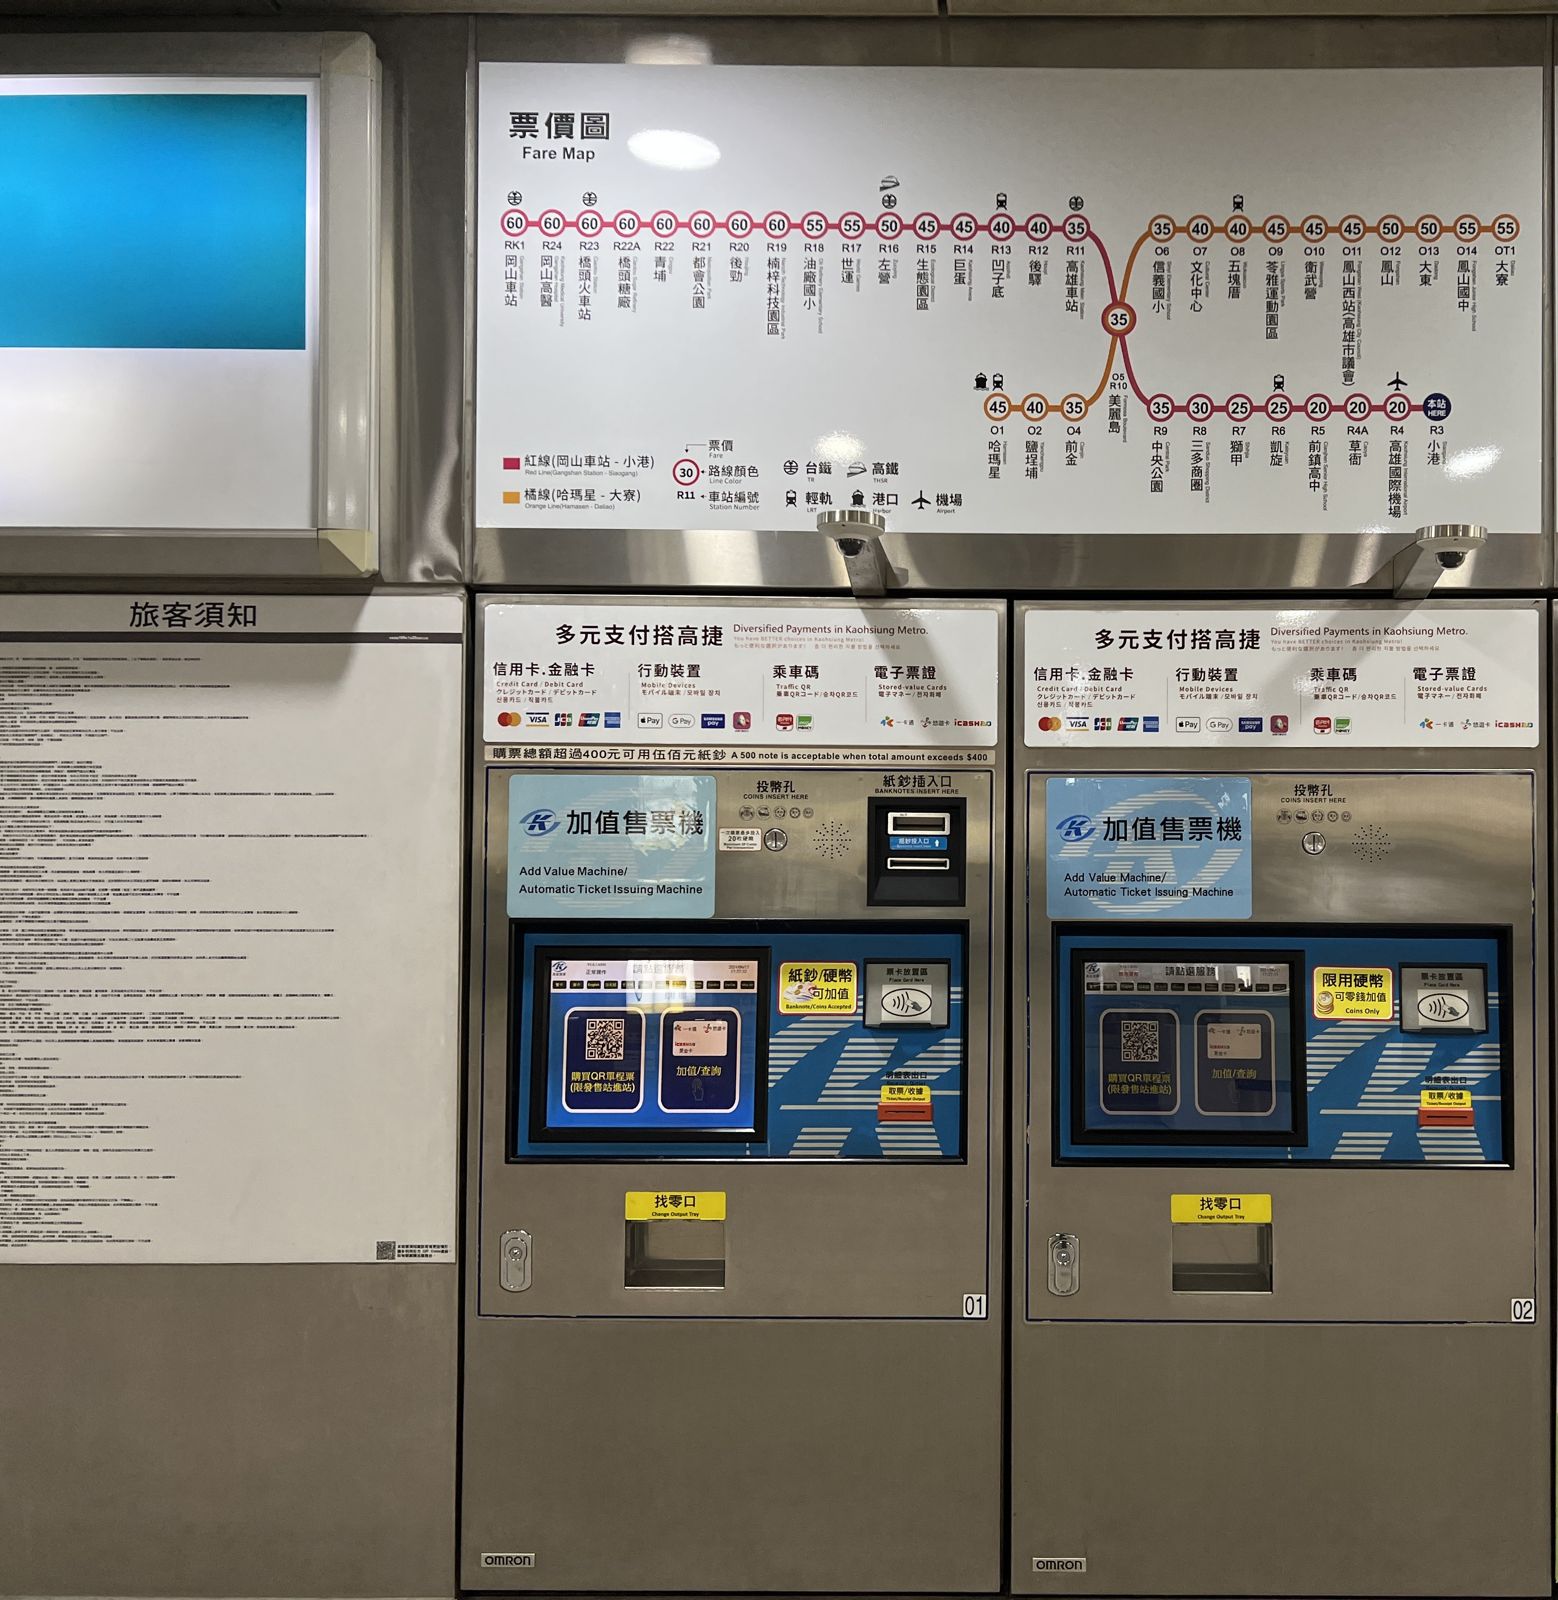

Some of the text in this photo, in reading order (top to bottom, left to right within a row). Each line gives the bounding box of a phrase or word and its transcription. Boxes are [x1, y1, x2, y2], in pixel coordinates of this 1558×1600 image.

[509, 112, 609, 139] 票價圖
[523, 147, 595, 162] Fare Map
[507, 217, 522, 229] 60
[582, 218, 599, 231] 60
[805, 220, 824, 233] 55
[880, 219, 899, 233] 50
[955, 221, 973, 234] 45
[1029, 220, 1048, 234] 40
[1067, 221, 1085, 235] 35
[1267, 222, 1284, 235] 45
[1420, 223, 1438, 236] 50
[1496, 221, 1515, 235] 55
[505, 241, 524, 249] RK1
[614, 242, 640, 250] R22A
[767, 243, 786, 252] R19
[879, 244, 898, 253] R16
[992, 245, 1011, 254] R13
[1067, 246, 1084, 255] R11
[1304, 247, 1324, 256] O10
[1457, 247, 1477, 255] O14
[1495, 246, 1514, 255] OT1
[730, 257, 742, 282] 後勁
[841, 258, 854, 283] 世運
[954, 259, 966, 284] 巨蛋
[1381, 261, 1394, 285] 鳳山
[1420, 260, 1432, 286] 大東
[1496, 260, 1508, 286] 大寮
[505, 255, 517, 306] 岡山車站
[541, 256, 552, 307] 岡山高醫
[693, 257, 705, 308] 都會公園
[804, 257, 816, 310] 油廠國小
[917, 259, 929, 310] 生態園區
[992, 260, 1004, 298] 凹子底
[1228, 260, 1240, 298] 五塊厝
[579, 256, 591, 320] 橋頭火車站
[1065, 260, 1078, 312] 高雄車站
[1190, 261, 1203, 312] 文化中心
[1108, 311, 1129, 327] 35
[989, 401, 1007, 415] 45
[1191, 402, 1209, 415] 30
[1269, 401, 1288, 415] 25
[1388, 402, 1406, 415] 20
[1427, 399, 1446, 408] 本站
[1109, 394, 1121, 433] 美麗島
[1028, 426, 1042, 435] O2
[1154, 427, 1167, 435] R9
[1233, 427, 1246, 435] R7
[1348, 426, 1368, 435] R4A
[1430, 426, 1444, 434] R3
[709, 440, 733, 451] 票價
[988, 440, 1001, 478] 哈瑪星
[1270, 441, 1283, 466] 凱旋
[1428, 440, 1440, 465] 小港
[525, 455, 654, 469] 紅線(岡山車站 小港)
[1025, 441, 1038, 479] 鹽埕埔
[1151, 440, 1163, 492] 中央公園
[1191, 441, 1203, 491] 三多商圈
[1309, 440, 1321, 492] 前鎮高中
[680, 468, 693, 477] 30
[709, 465, 759, 480] 路線顏色
[806, 461, 832, 475] 台鐵
[873, 462, 898, 475] 高鐵
[1389, 440, 1402, 518] 高雄國際機場
[525, 488, 640, 502] 橘線(哈瑪星 大寮)
[678, 491, 695, 499] R11
[709, 491, 759, 503] 車站編號
[806, 492, 832, 504] 輕軌
[873, 493, 898, 505] 港口
[936, 493, 962, 506] 機場
[130, 602, 256, 628] 旅客須知
[556, 624, 723, 646] 多元支付搭高捷
[734, 624, 928, 636] Diversified Payments Kaohsiung Metro.
[1095, 629, 1260, 649] 多元支付搭高捷
[493, 662, 594, 676] 信用卡.金融卡
[638, 664, 700, 677] 行動裝置
[773, 665, 818, 679] 乘車碼
[875, 666, 936, 679] 電子票證
[1176, 668, 1237, 681] 行動裝置
[1413, 667, 1476, 681] 電子票證
[1185, 721, 1198, 729] Pay
[493, 747, 727, 760] 購票總額超過400元可用伍佰元紙鈔
[791, 753, 841, 761] acceptable
[883, 775, 951, 787] 紙鈔插入口
[757, 781, 795, 795] 投幣孔
[1294, 784, 1333, 796] 投幣孔
[568, 810, 703, 835] 加值售票機
[1103, 817, 1242, 841] 加值售票機
[520, 866, 627, 877] Add Value Machine/
[519, 884, 702, 896] Automatic Ticket Issuing Machine
[1064, 887, 1233, 898] Automatic Ticket Issuing Machine
[788, 968, 852, 982] 紙鈔/硬幣
[1165, 966, 1216, 976] 請點選服務
[1323, 973, 1383, 988] 限用硬幣
[813, 988, 848, 1000] 可加值
[1336, 992, 1386, 1002] 可零錢加值
[571, 1072, 635, 1081] 購買QR單程票
[676, 1066, 721, 1076] 加值/查詢
[571, 1083, 635, 1093] (限發售站進站)
[655, 1195, 695, 1208] 找零口
[1200, 1197, 1240, 1210] 找零口
[965, 1297, 984, 1316] 01
[1513, 1302, 1532, 1319] 02
[485, 1556, 531, 1566] OMRON
[1036, 1560, 1082, 1570] OMRON
